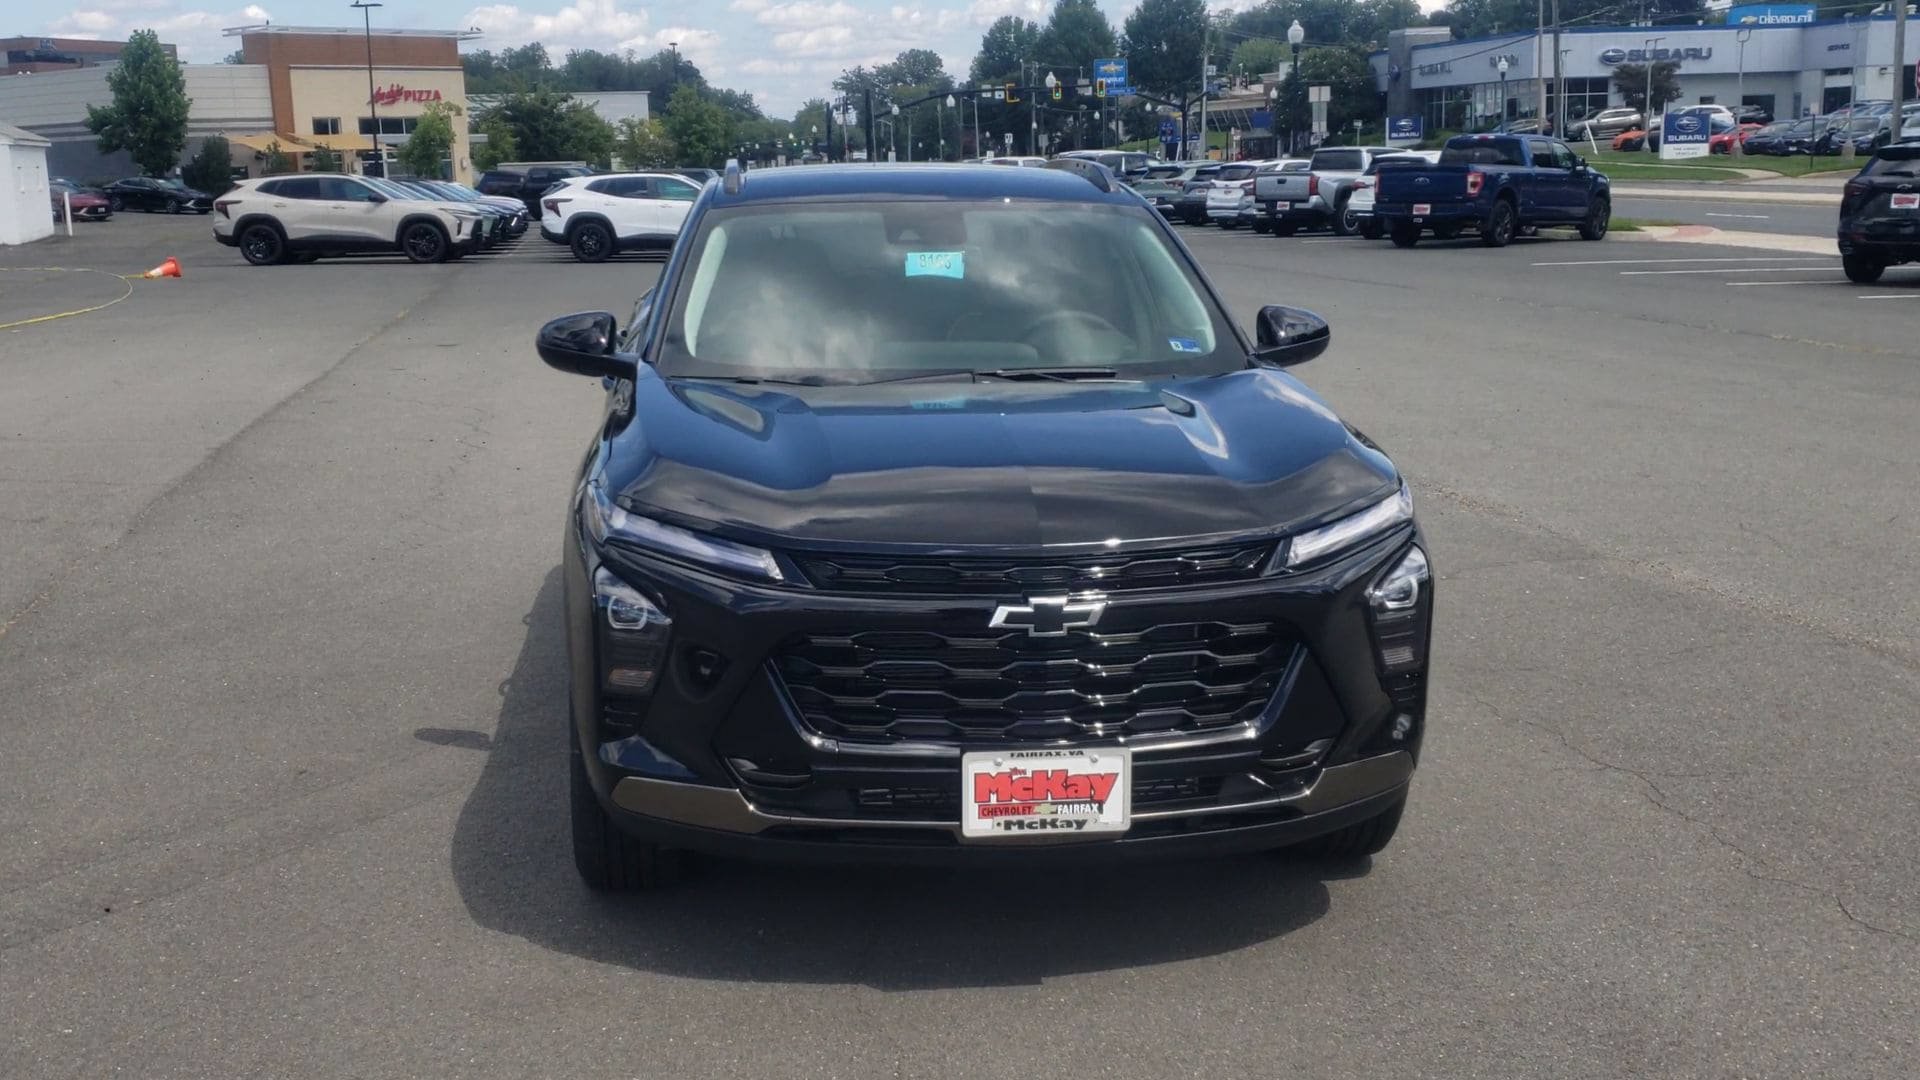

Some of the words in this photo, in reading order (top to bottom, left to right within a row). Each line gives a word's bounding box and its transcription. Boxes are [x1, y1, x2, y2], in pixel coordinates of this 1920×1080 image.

[1627, 47, 1712, 61] SUBARU
[403, 89, 442, 103] PIZZA
[1668, 134, 1706, 142] SUBARU
[974, 769, 1119, 804] McKay
[981, 806, 1033, 817] CHEVROLET
[1057, 803, 1099, 815] FAIRFAX
[1003, 818, 1088, 831] McKay
